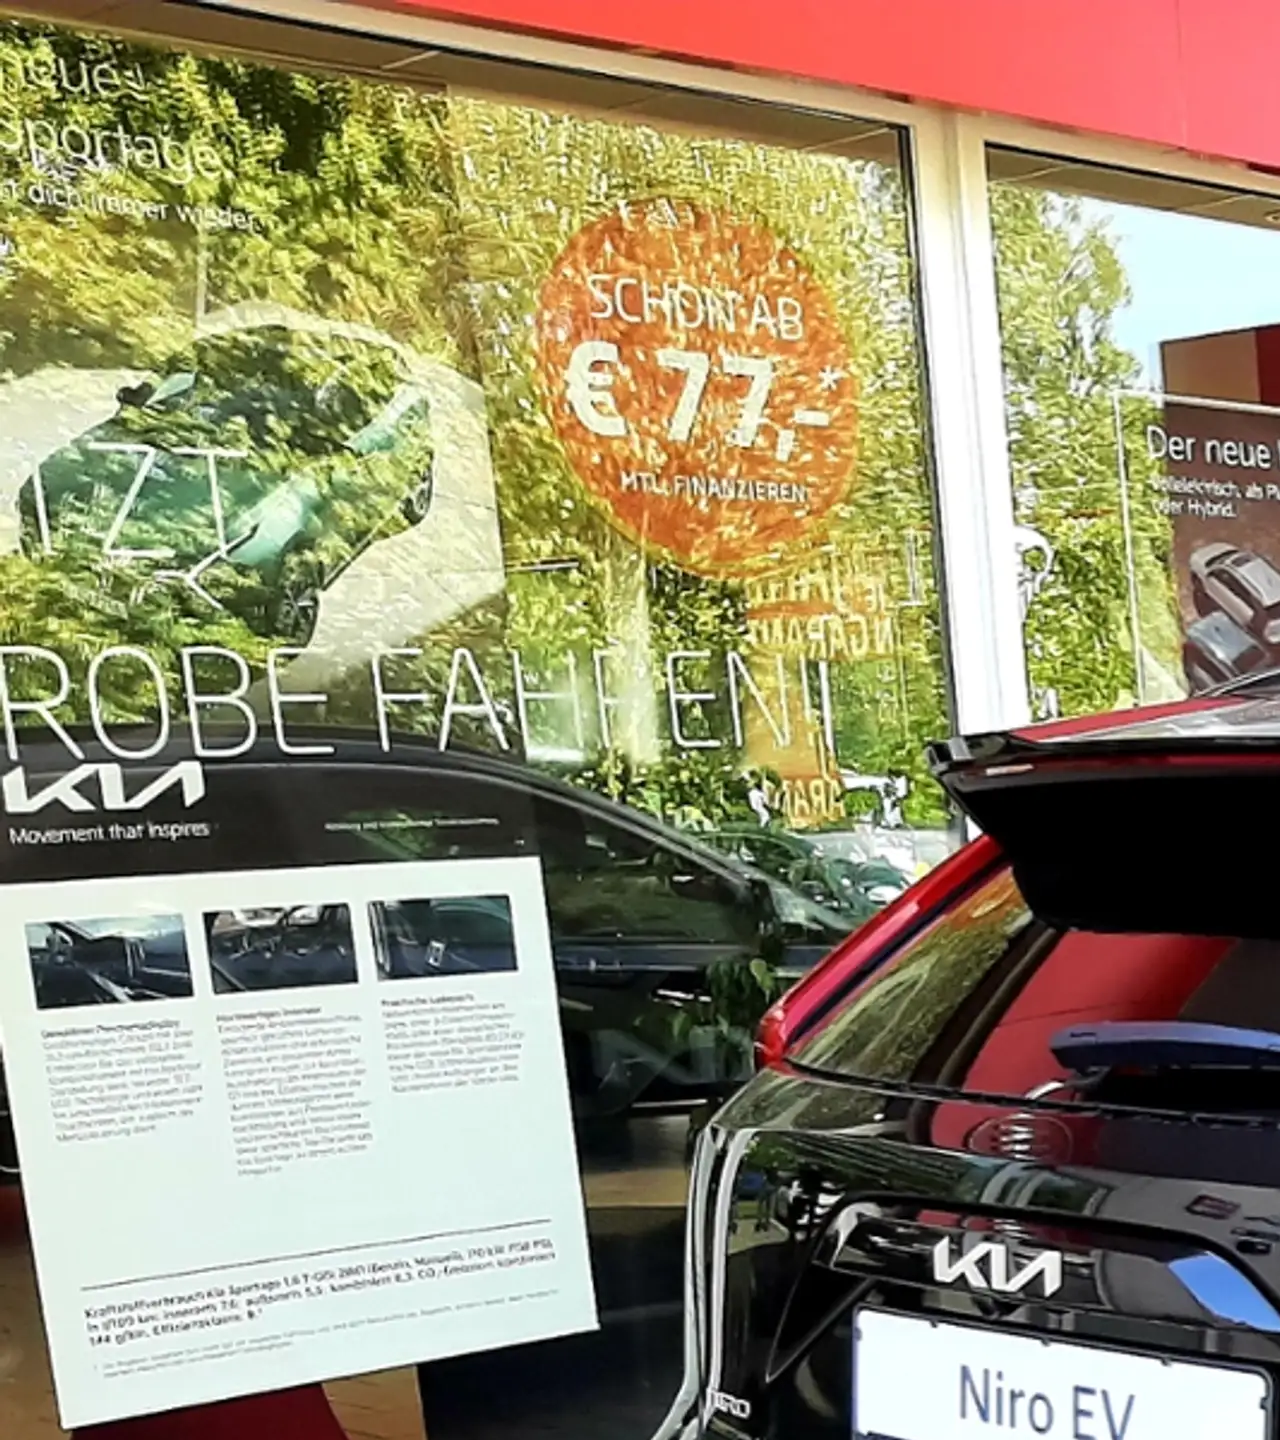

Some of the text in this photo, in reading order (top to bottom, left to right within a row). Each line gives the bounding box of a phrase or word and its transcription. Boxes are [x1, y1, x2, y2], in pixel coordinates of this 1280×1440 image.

[749, 294, 803, 341] AB
[566, 340, 628, 437] €
[1146, 424, 1196, 462] Der
[1205, 438, 1271, 469] neue
[673, 476, 810, 502] FINANZIEREN
[2, 761, 205, 813] KIA
[8, 820, 211, 846] Movement that inspires
[933, 1234, 1063, 1298] KIA
[959, 1364, 1055, 1435] Niro
